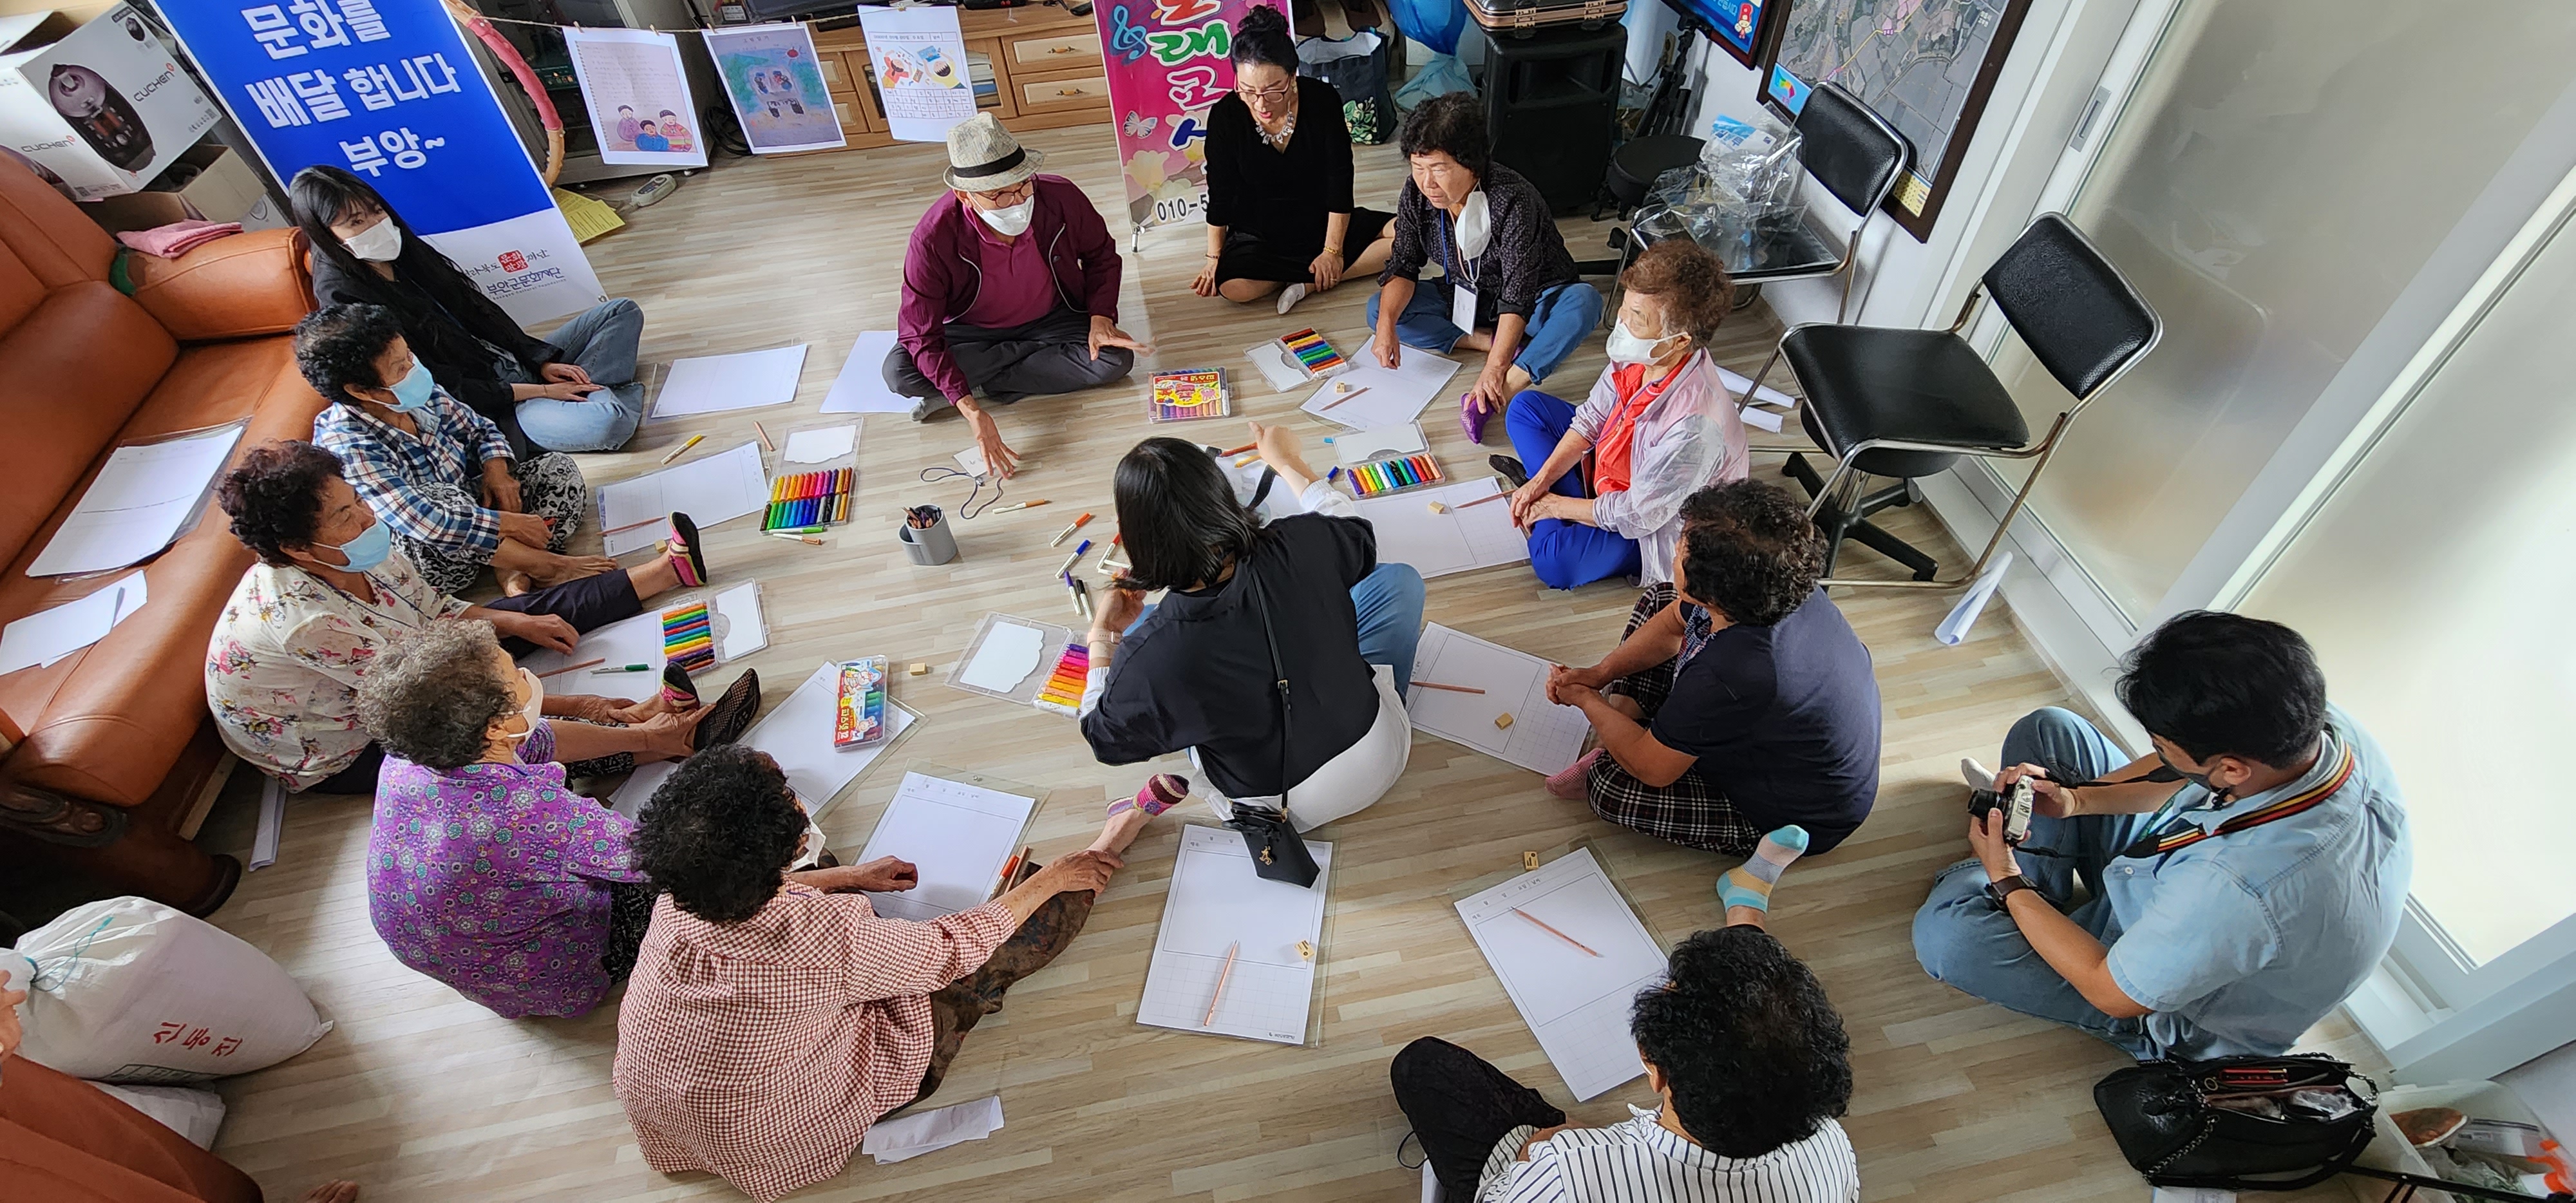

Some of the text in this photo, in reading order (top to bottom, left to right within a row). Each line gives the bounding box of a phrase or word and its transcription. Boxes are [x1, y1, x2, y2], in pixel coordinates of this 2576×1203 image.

[241, 0, 392, 60] 문화를
[133, 70, 175, 102] CUCHEN
[244, 68, 352, 129] 배달
[343, 53, 462, 111] 합니다
[21, 139, 74, 153] CUCHEN
[338, 127, 446, 178] 부앙~
[486, 267, 565, 295] 부안군문화재단
